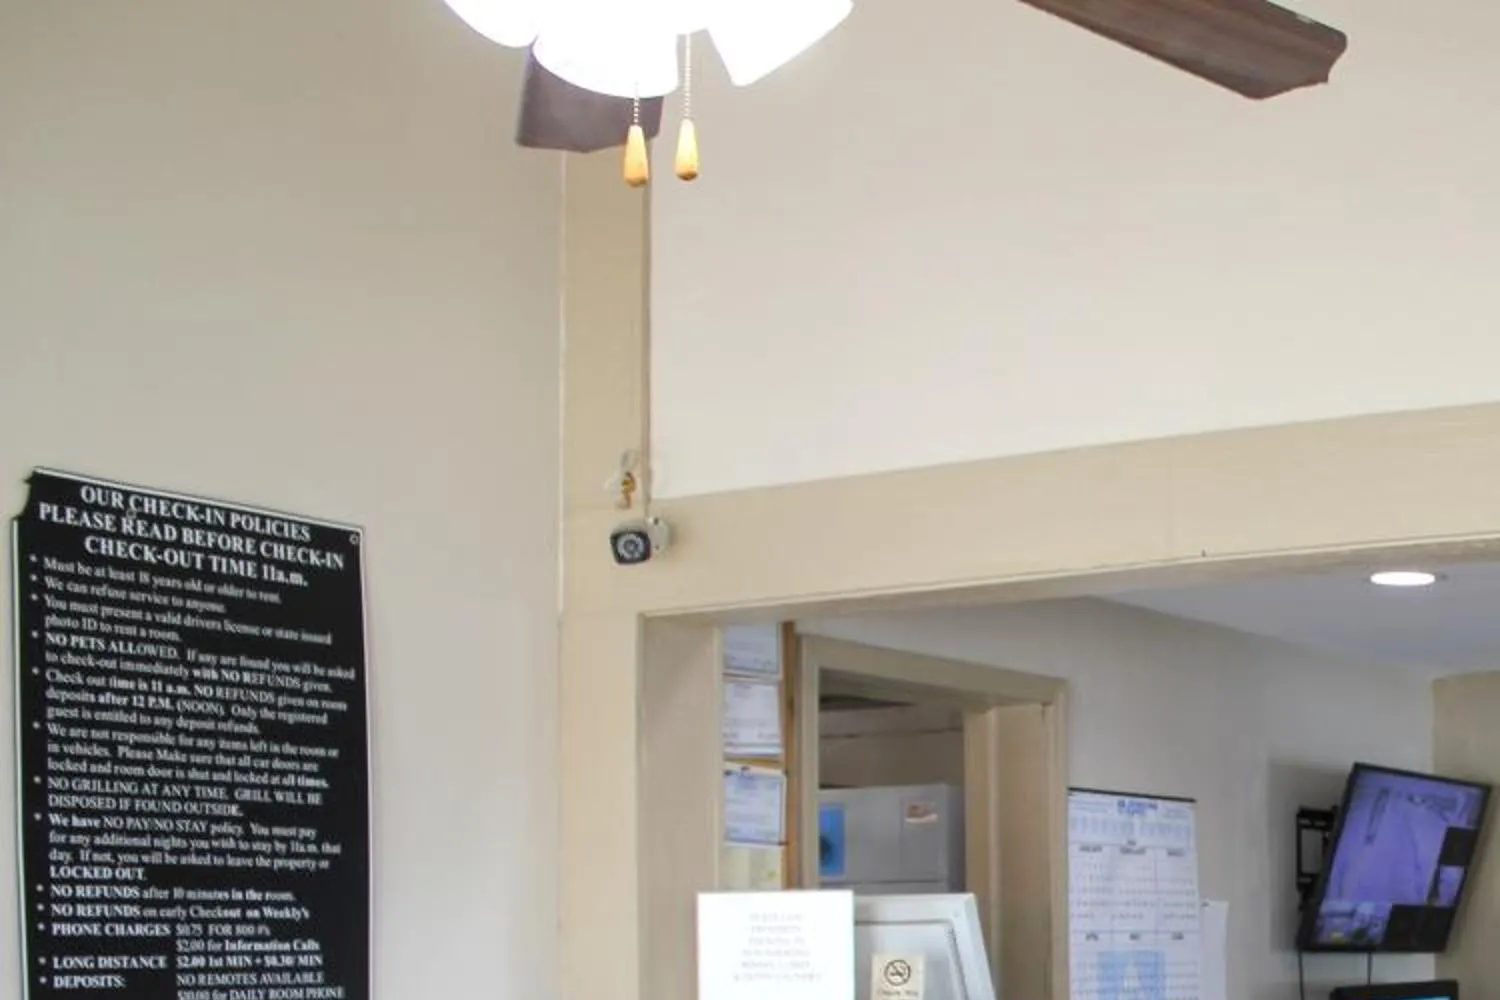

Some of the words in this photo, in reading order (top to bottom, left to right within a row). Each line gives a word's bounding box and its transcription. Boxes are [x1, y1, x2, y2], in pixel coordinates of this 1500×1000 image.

[39, 502, 116, 531] PLEASE
[121, 516, 177, 540] READ
[181, 527, 256, 554] BEFORE
[259, 541, 343, 568] CHECK-IN
[80, 485, 124, 508] OUR
[128, 494, 224, 525] CHECK-IN
[230, 511, 310, 541] POLICIES
[84, 535, 204, 569] CHECK-OUT
[208, 554, 256, 578] TIME
